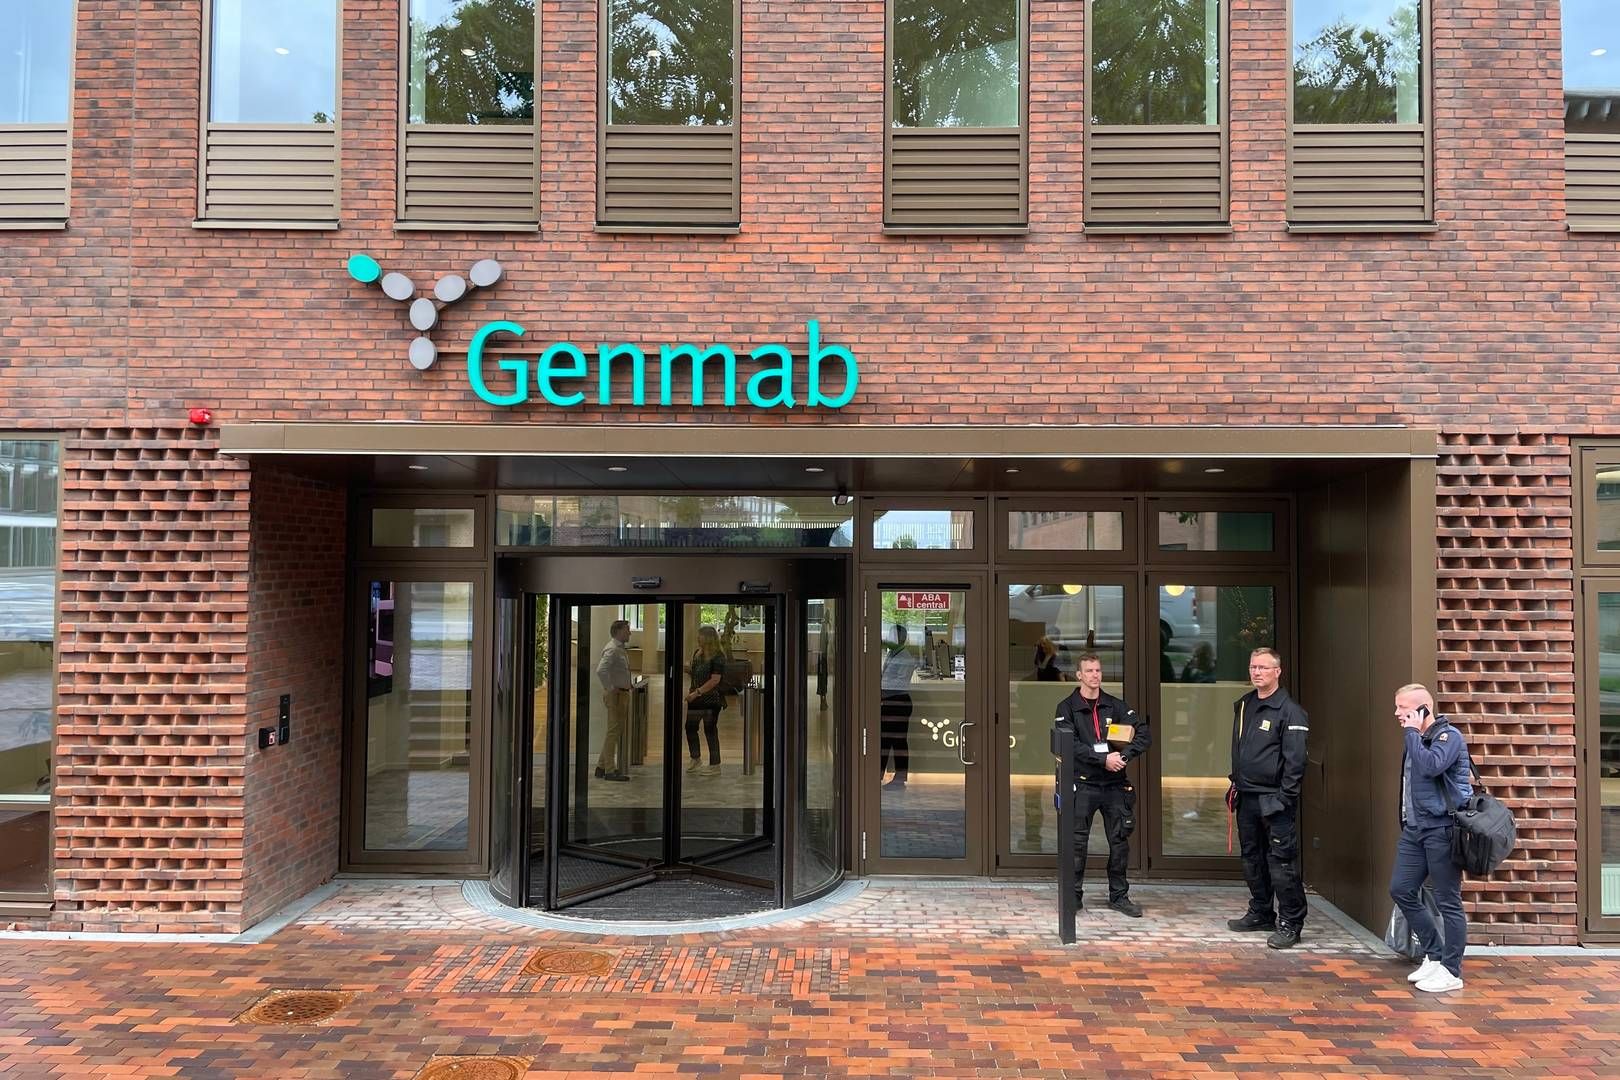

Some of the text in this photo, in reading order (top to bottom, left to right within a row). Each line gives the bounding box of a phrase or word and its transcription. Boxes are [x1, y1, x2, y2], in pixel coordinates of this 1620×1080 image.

[466, 319, 859, 409] Genmab
[921, 593, 941, 601] ABA
[916, 601, 946, 609] central
